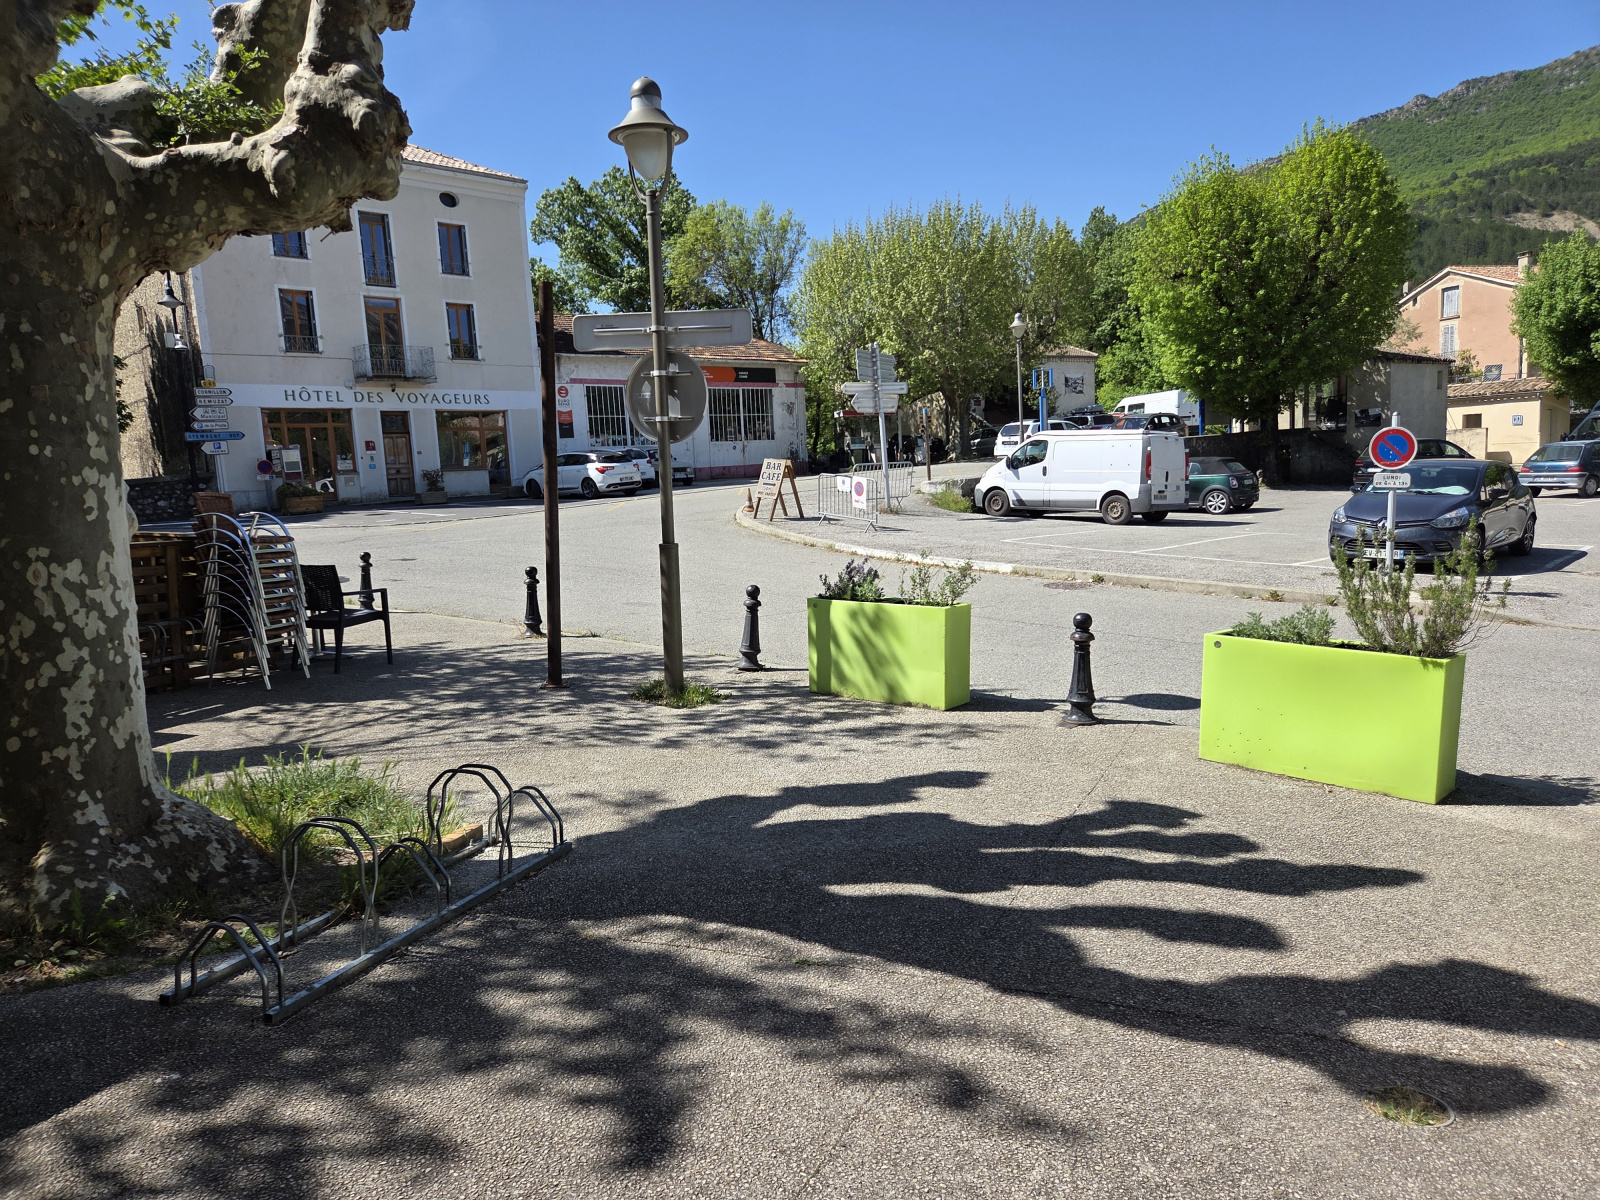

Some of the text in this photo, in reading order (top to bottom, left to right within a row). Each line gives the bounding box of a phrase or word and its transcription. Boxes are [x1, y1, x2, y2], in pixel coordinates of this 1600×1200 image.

[284, 387, 490, 405] HÔTEL DES VOYAGEURS
[766, 462, 782, 470] BAR
